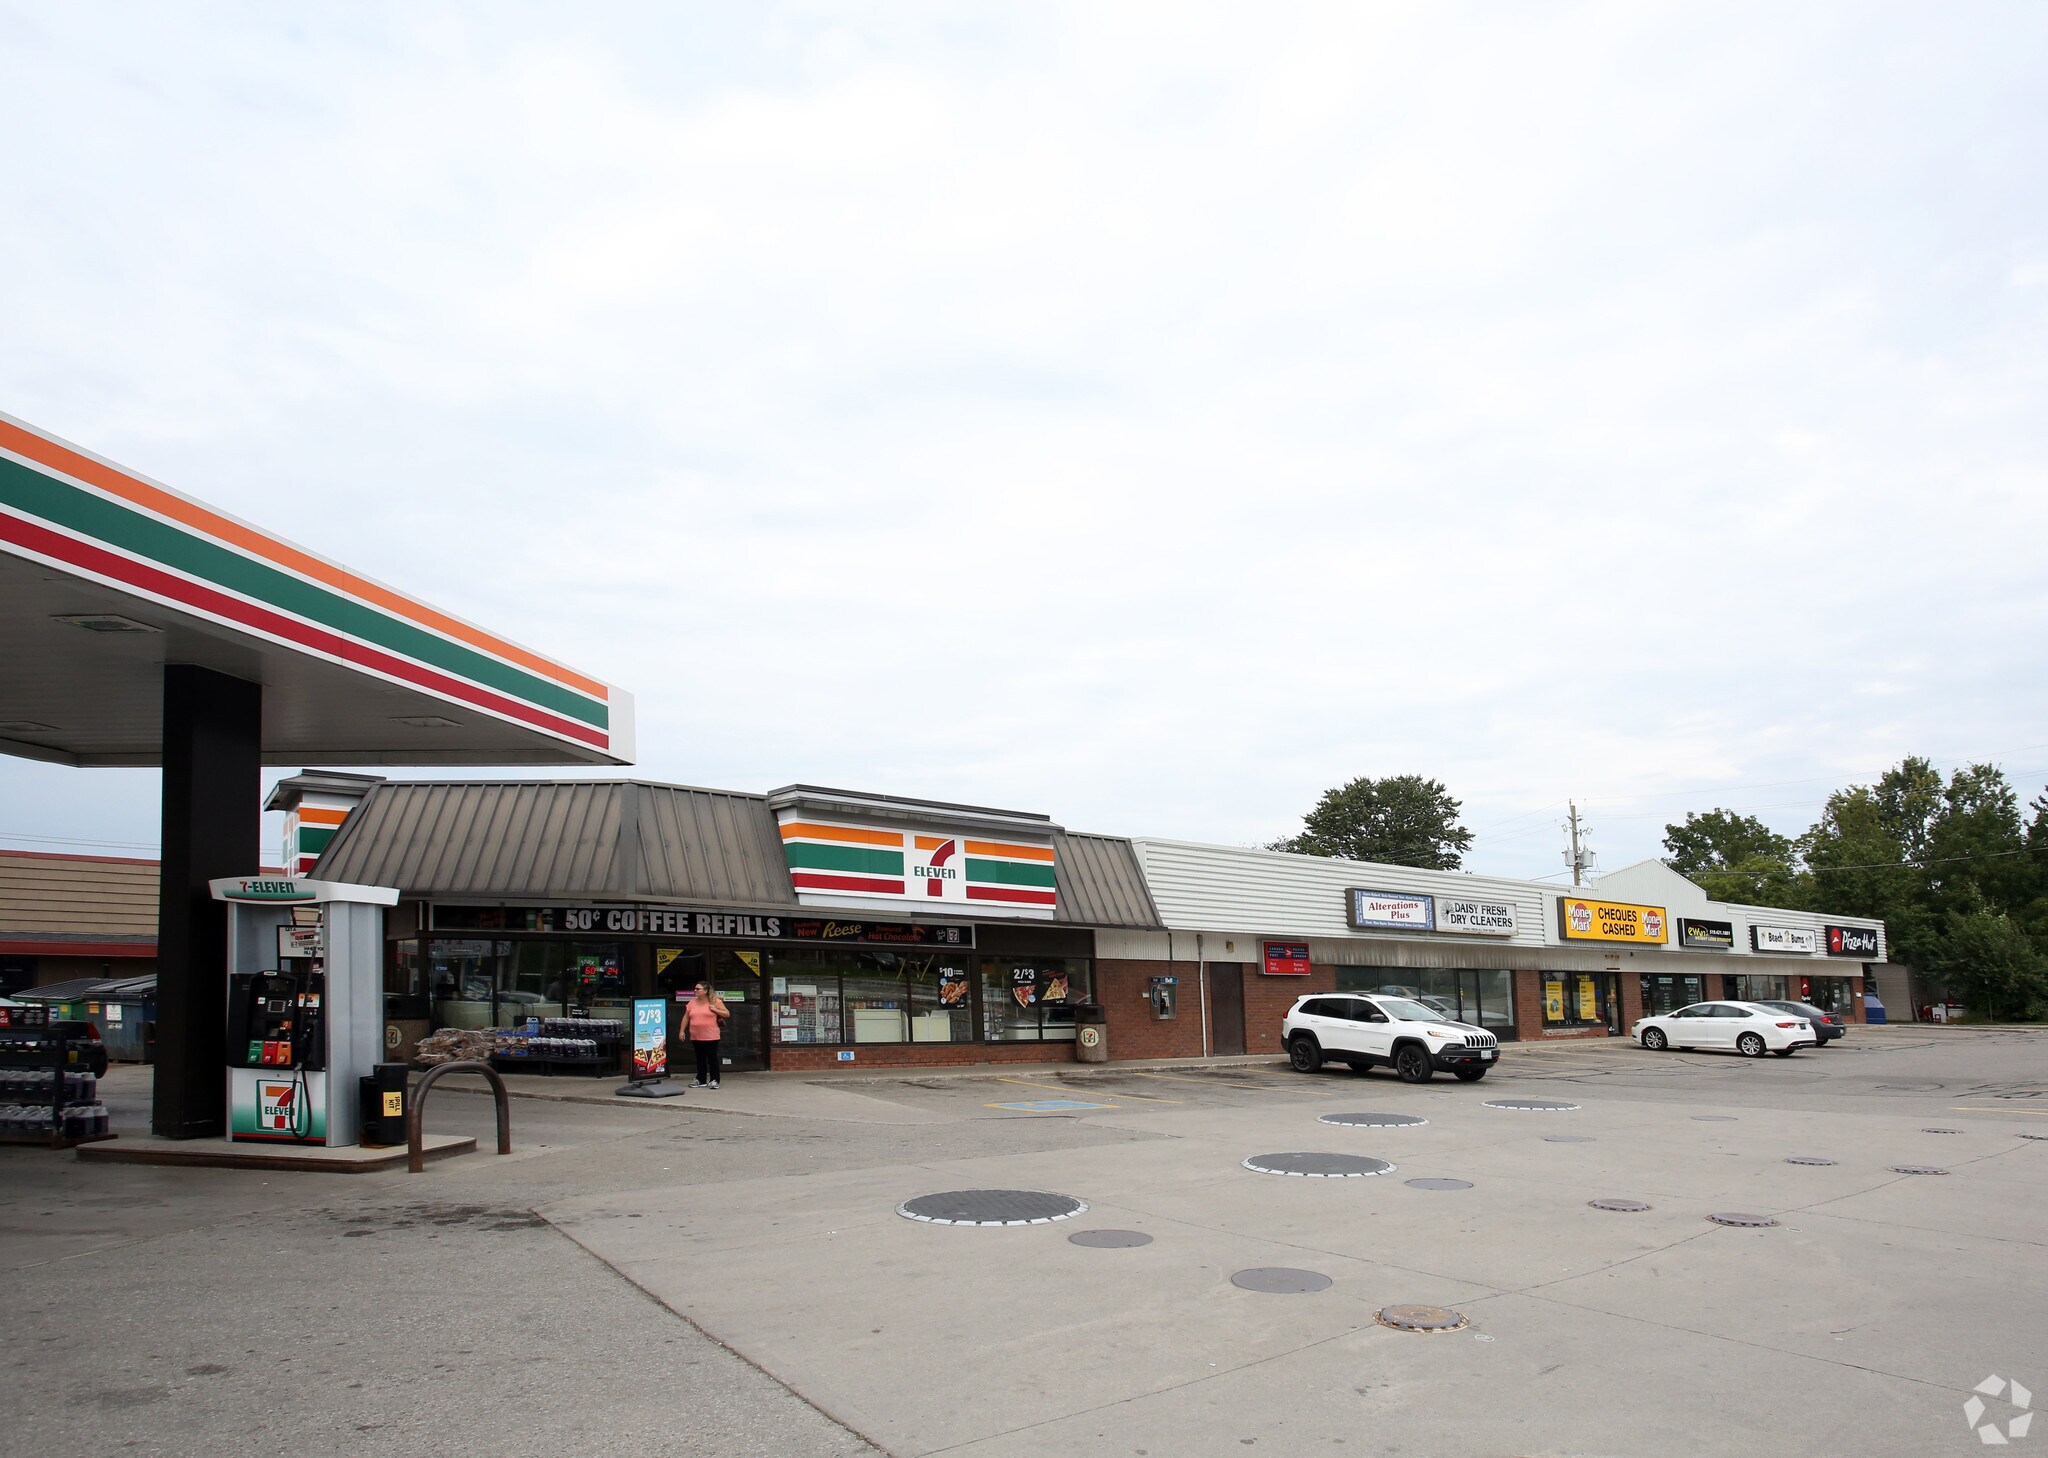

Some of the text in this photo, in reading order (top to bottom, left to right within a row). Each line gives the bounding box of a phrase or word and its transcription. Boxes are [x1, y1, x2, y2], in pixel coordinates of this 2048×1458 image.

[914, 866, 956, 879] ELEVEN
[240, 881, 295, 893] 7-ELEVEN
[1368, 901, 1419, 911] Alterations
[1454, 902, 1507, 916] DAISY FRESH
[1391, 911, 1410, 919] Plus
[1568, 904, 1593, 922] Money
[1598, 907, 1637, 922] CHEQUES
[1641, 911, 1663, 926] Money
[606, 910, 690, 933] COFFEE
[696, 913, 781, 937] REFILLS
[1450, 914, 1513, 928] DRY CLEANERS
[1571, 918, 1591, 931] Mart
[797, 928, 818, 937] New
[822, 921, 862, 938] Reese
[1602, 922, 1636, 936] CASHED
[1644, 923, 1661, 937] Mart
[868, 932, 921, 942] Hot Chocolate
[1768, 932, 1783, 943] Beach
[1841, 930, 1876, 950] Pizza Hut
[606, 967, 618, 976] 24
[939, 967, 954, 977] $10
[1013, 968, 1035, 980] 2/$3
[638, 1009, 662, 1025] 2/$3
